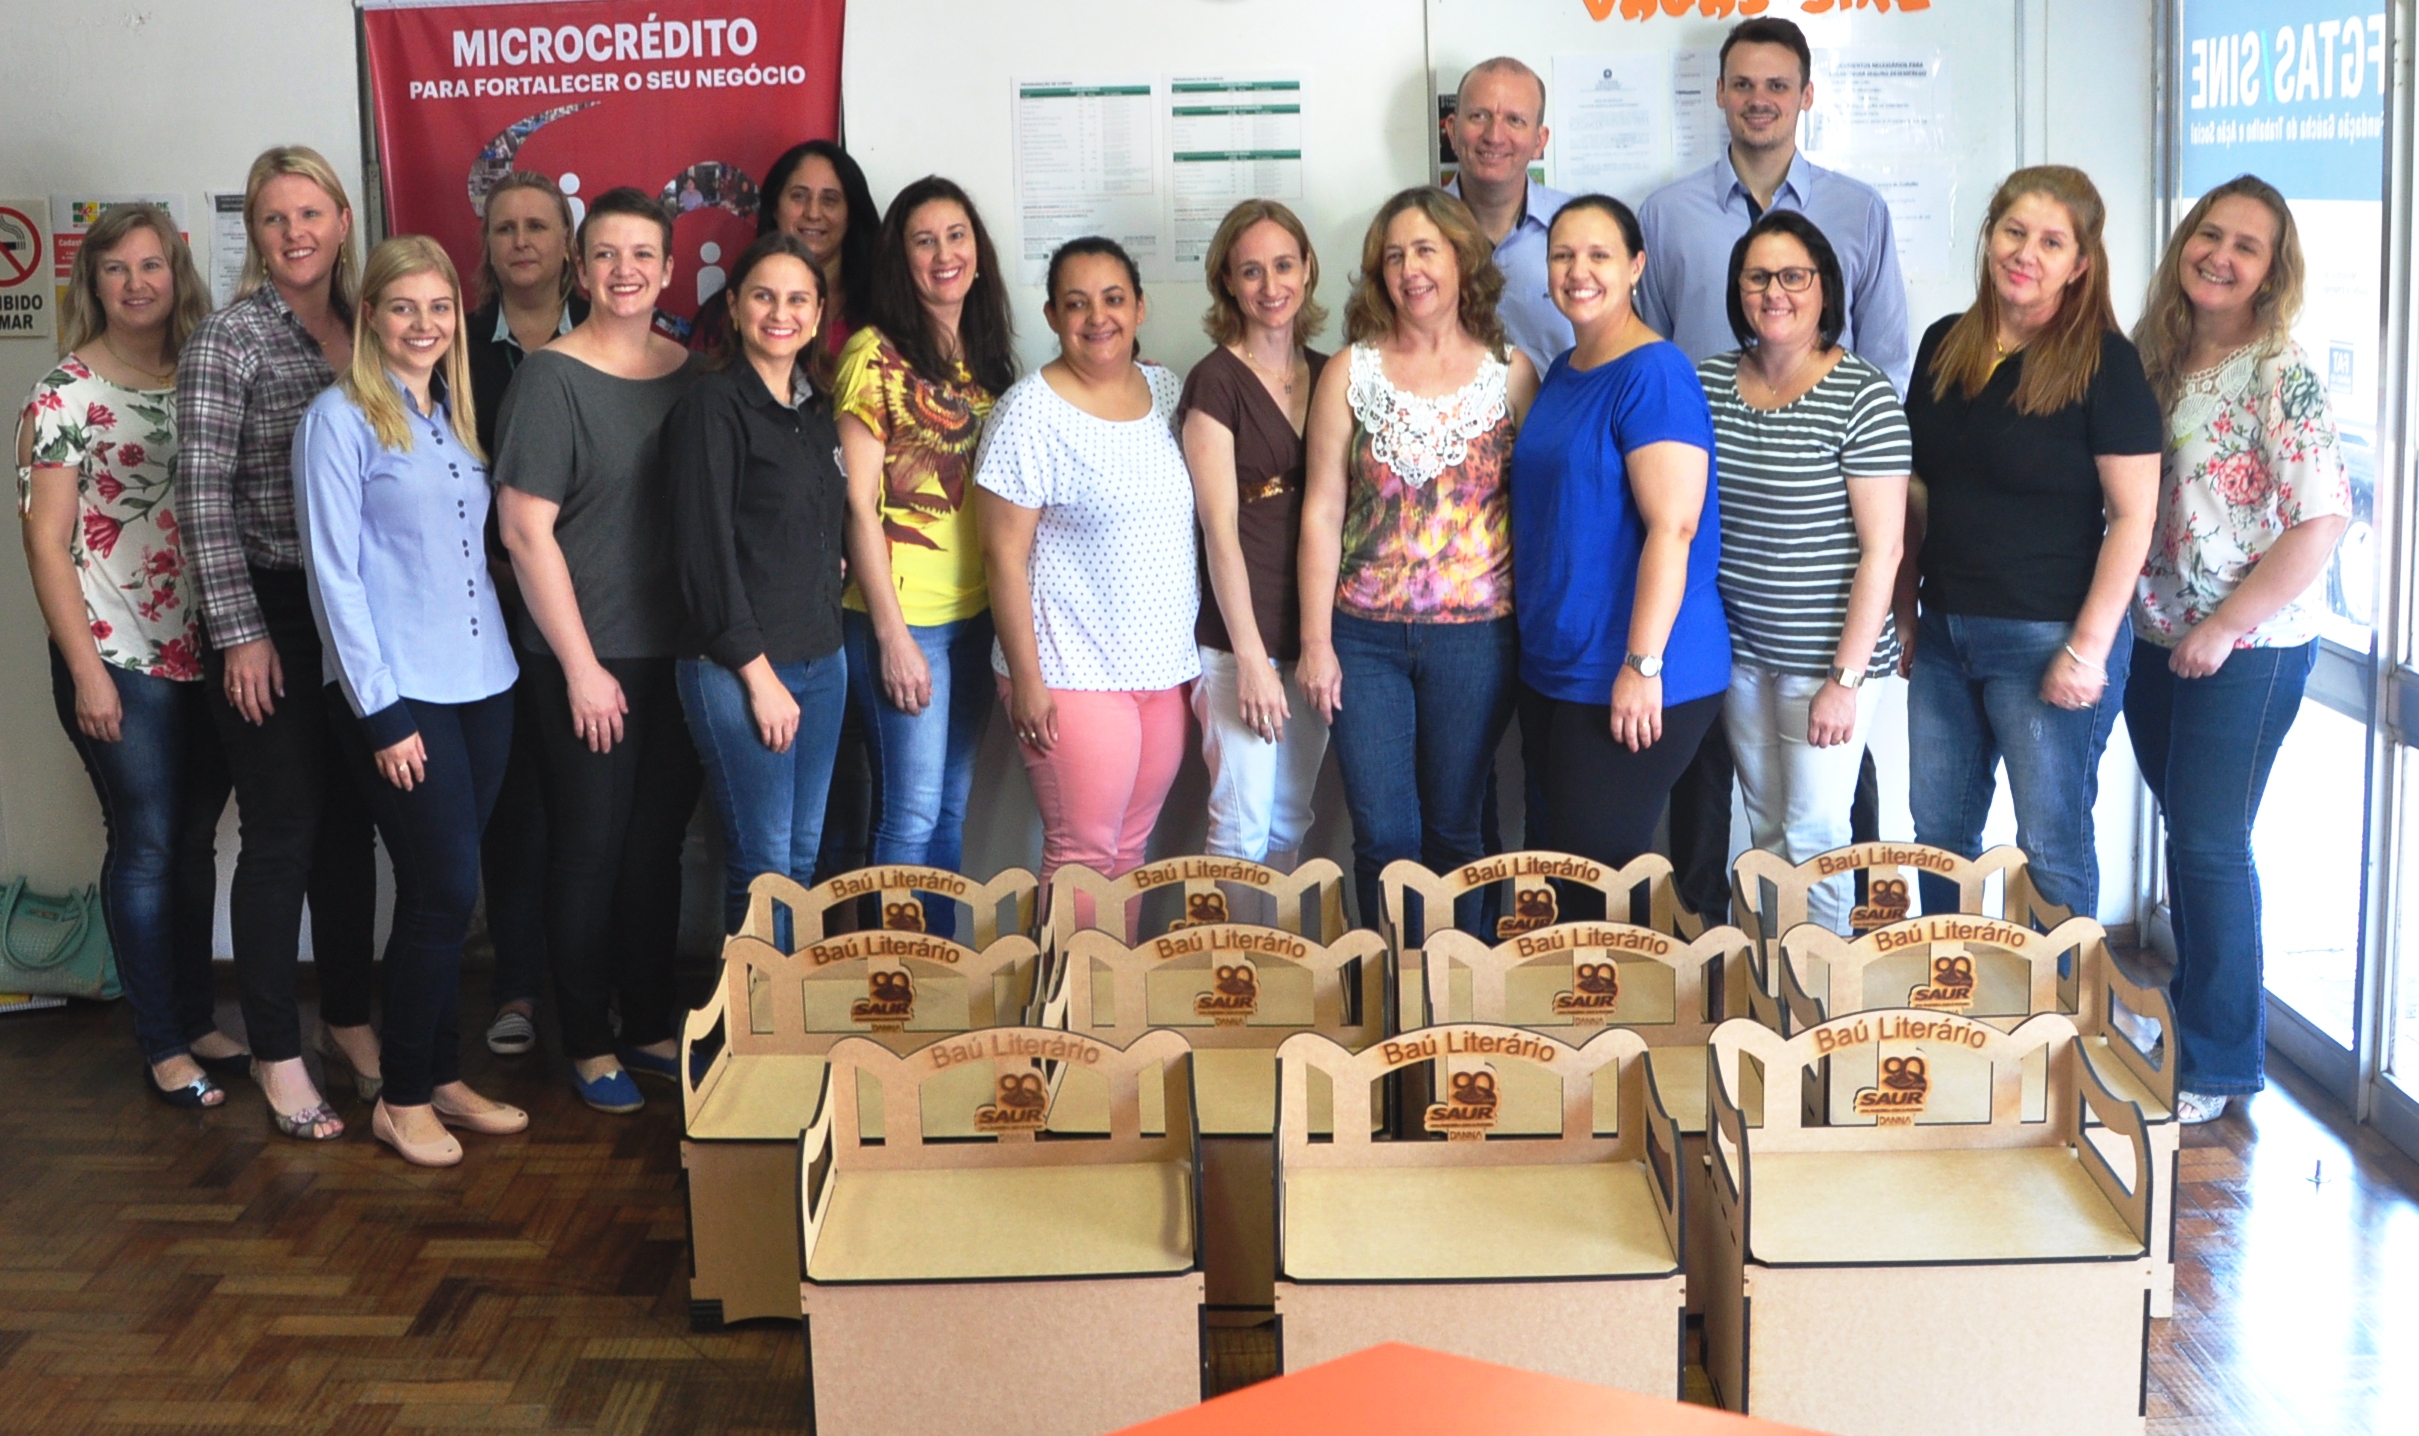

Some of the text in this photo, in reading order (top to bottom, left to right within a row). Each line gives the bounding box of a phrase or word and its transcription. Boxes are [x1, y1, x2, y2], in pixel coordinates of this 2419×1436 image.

[453, 13, 758, 67] MICROCRÉDITO
[410, 63, 806, 99] PARA FORTALECER O SEU NEGÓCIO
[1134, 860, 1270, 888] Baú Literário
[1464, 856, 1600, 885] Baú Literário
[1818, 847, 1955, 875] Baú Literário
[830, 869, 966, 898] Baú Literário
[1854, 908, 1905, 920] SAUR
[1156, 929, 1307, 958] Baú Literário
[1517, 927, 1669, 957] Baú Literário
[1875, 920, 2025, 951] Baú Literário
[812, 936, 960, 965] Baú Literário
[854, 1002, 910, 1015] SAUR
[1198, 996, 1252, 1008] SAUR
[1557, 995, 1614, 1008] SAUR
[1915, 988, 1970, 1000] SAUR
[1383, 1031, 1555, 1065] Baú Literário
[1815, 1016, 1986, 1052] Baú Literário
[931, 1033, 1101, 1068] Baú Literário
[1860, 1092, 1923, 1105] SAUR
[980, 1109, 1043, 1123] SAUR
[1430, 1107, 1493, 1120] SAUR
